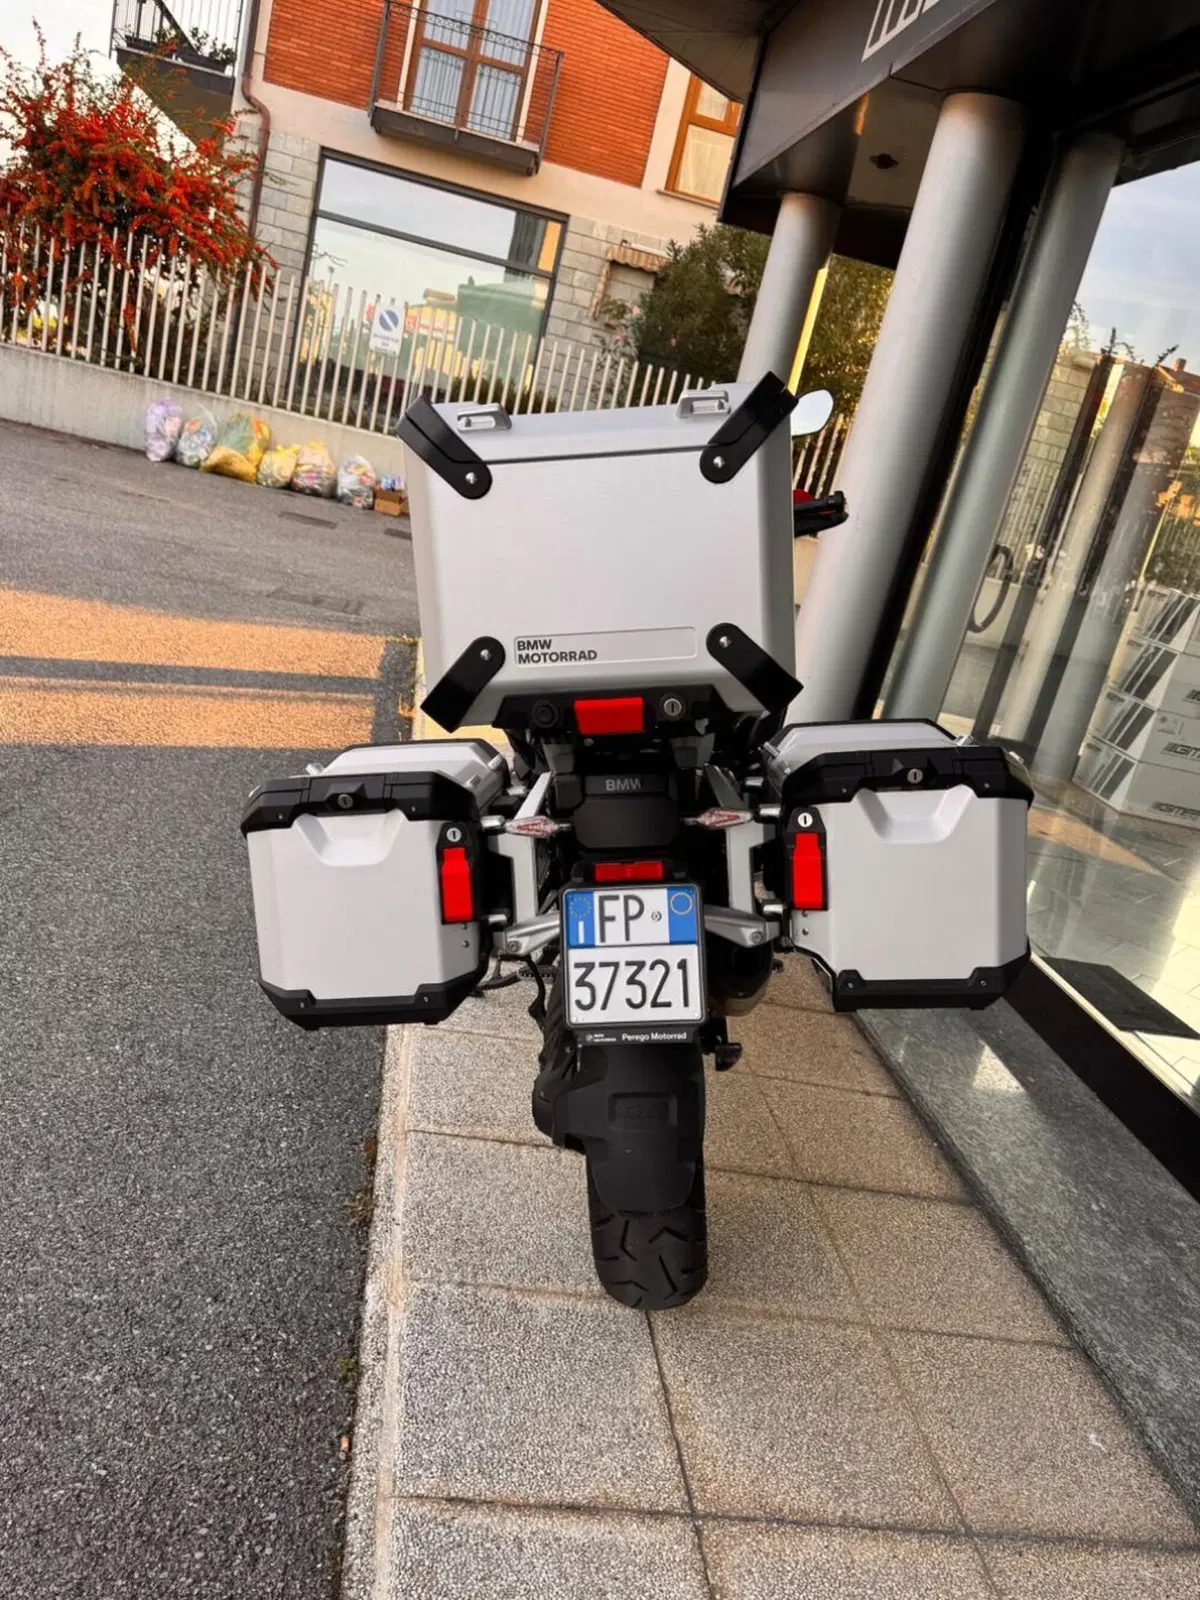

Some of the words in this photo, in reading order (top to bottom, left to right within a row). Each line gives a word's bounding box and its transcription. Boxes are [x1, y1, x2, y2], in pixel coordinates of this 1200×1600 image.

[517, 639, 552, 651] BMW
[518, 650, 597, 664] MOTORRAD
[606, 777, 643, 791] BMW
[598, 894, 645, 943] FP
[573, 958, 690, 1011] 37321
[621, 1033, 650, 1042] Perego
[650, 1032, 687, 1040] Motorrad
